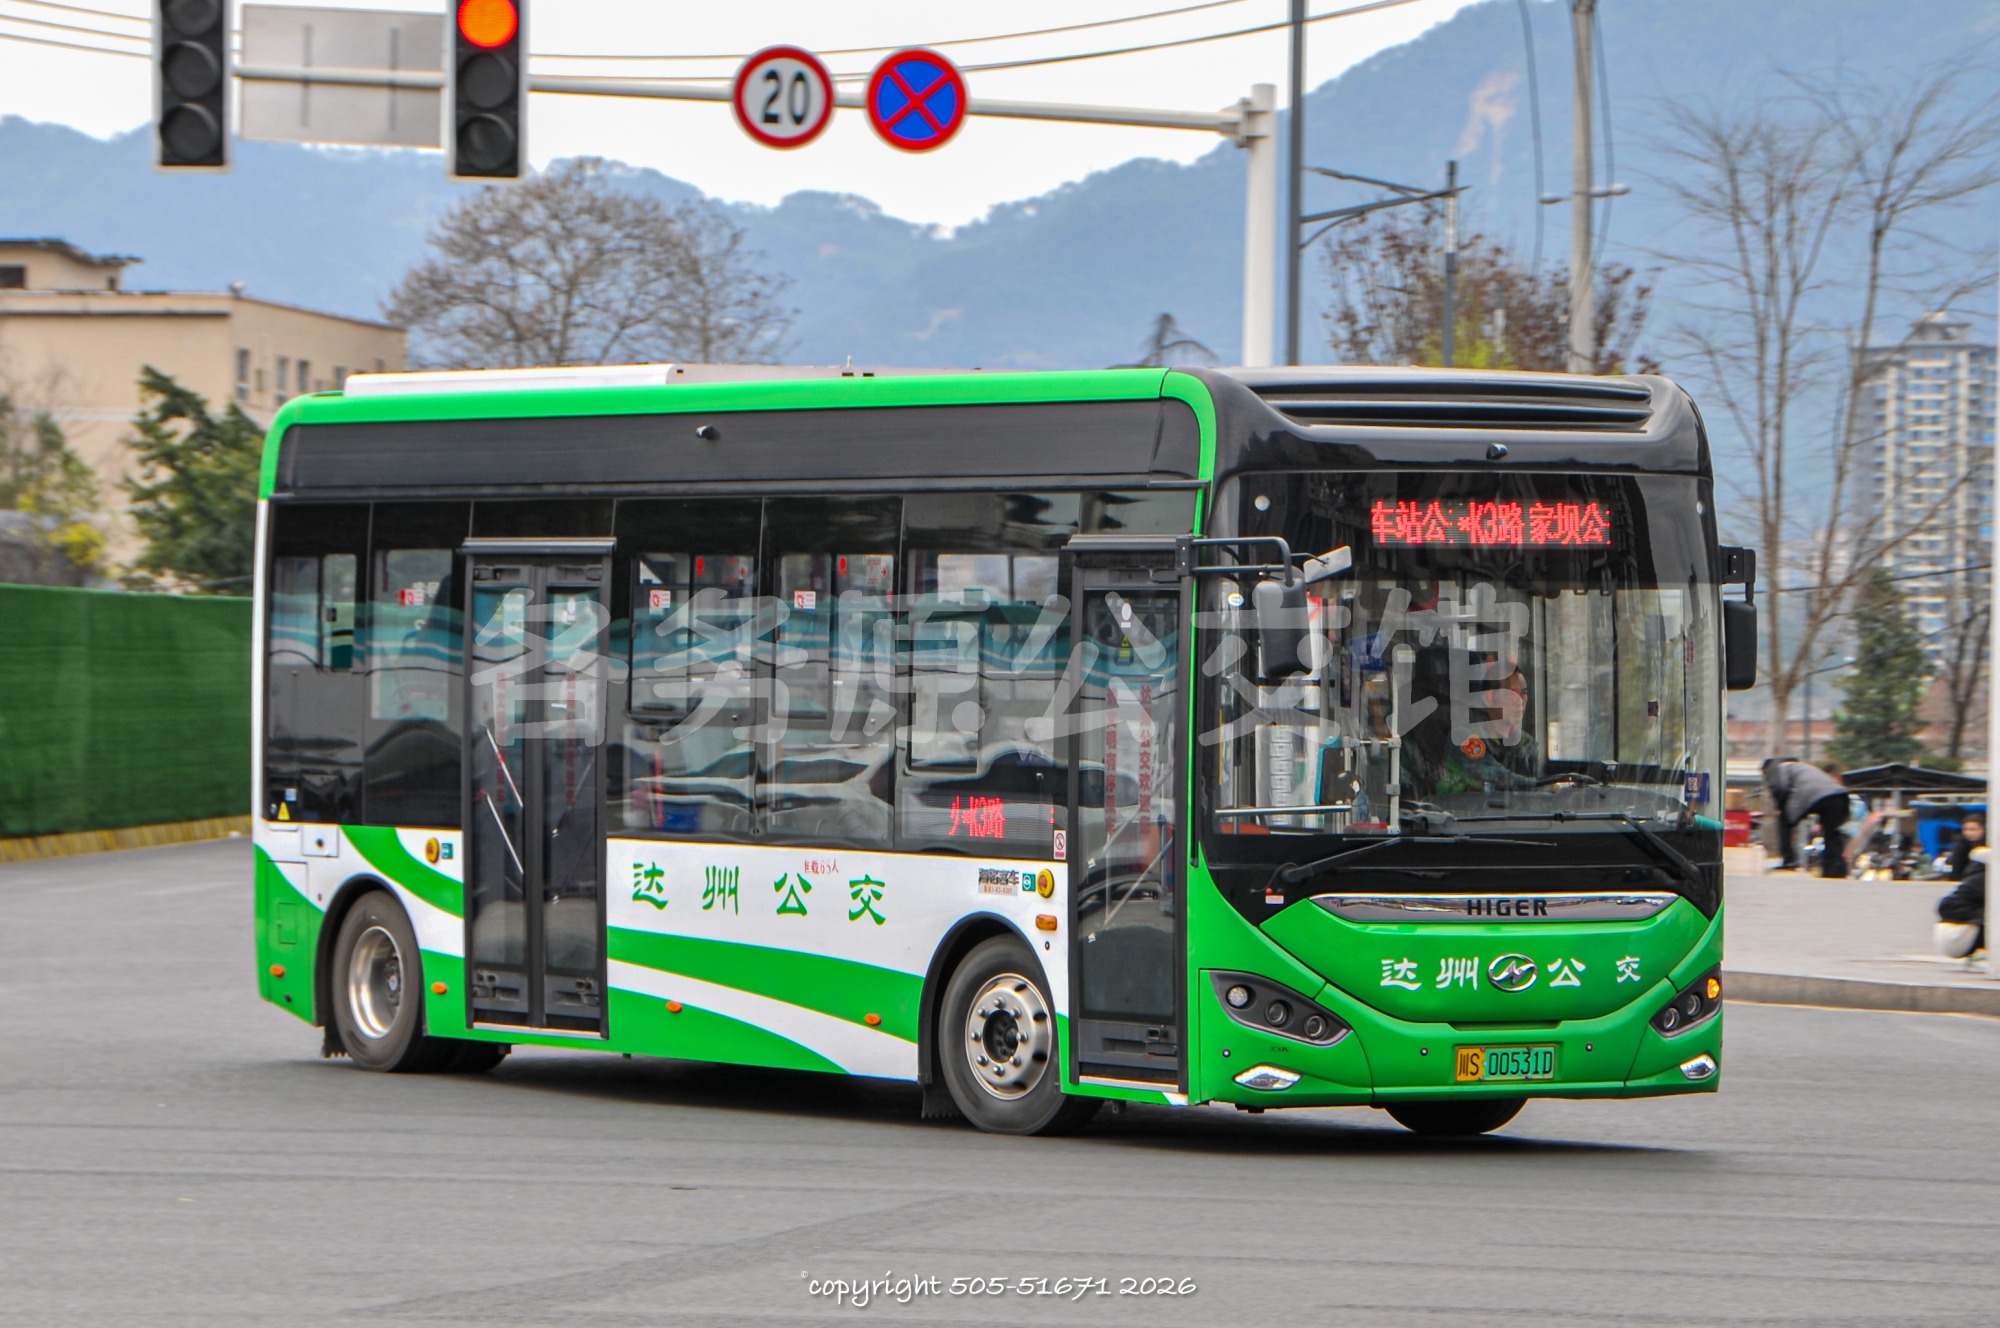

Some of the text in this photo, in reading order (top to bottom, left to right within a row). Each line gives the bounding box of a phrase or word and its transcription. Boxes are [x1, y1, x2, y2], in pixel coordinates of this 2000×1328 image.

[762, 69, 811, 126] 20
[632, 862, 886, 926] 达州公交
[1467, 899, 1548, 917] HIGER
